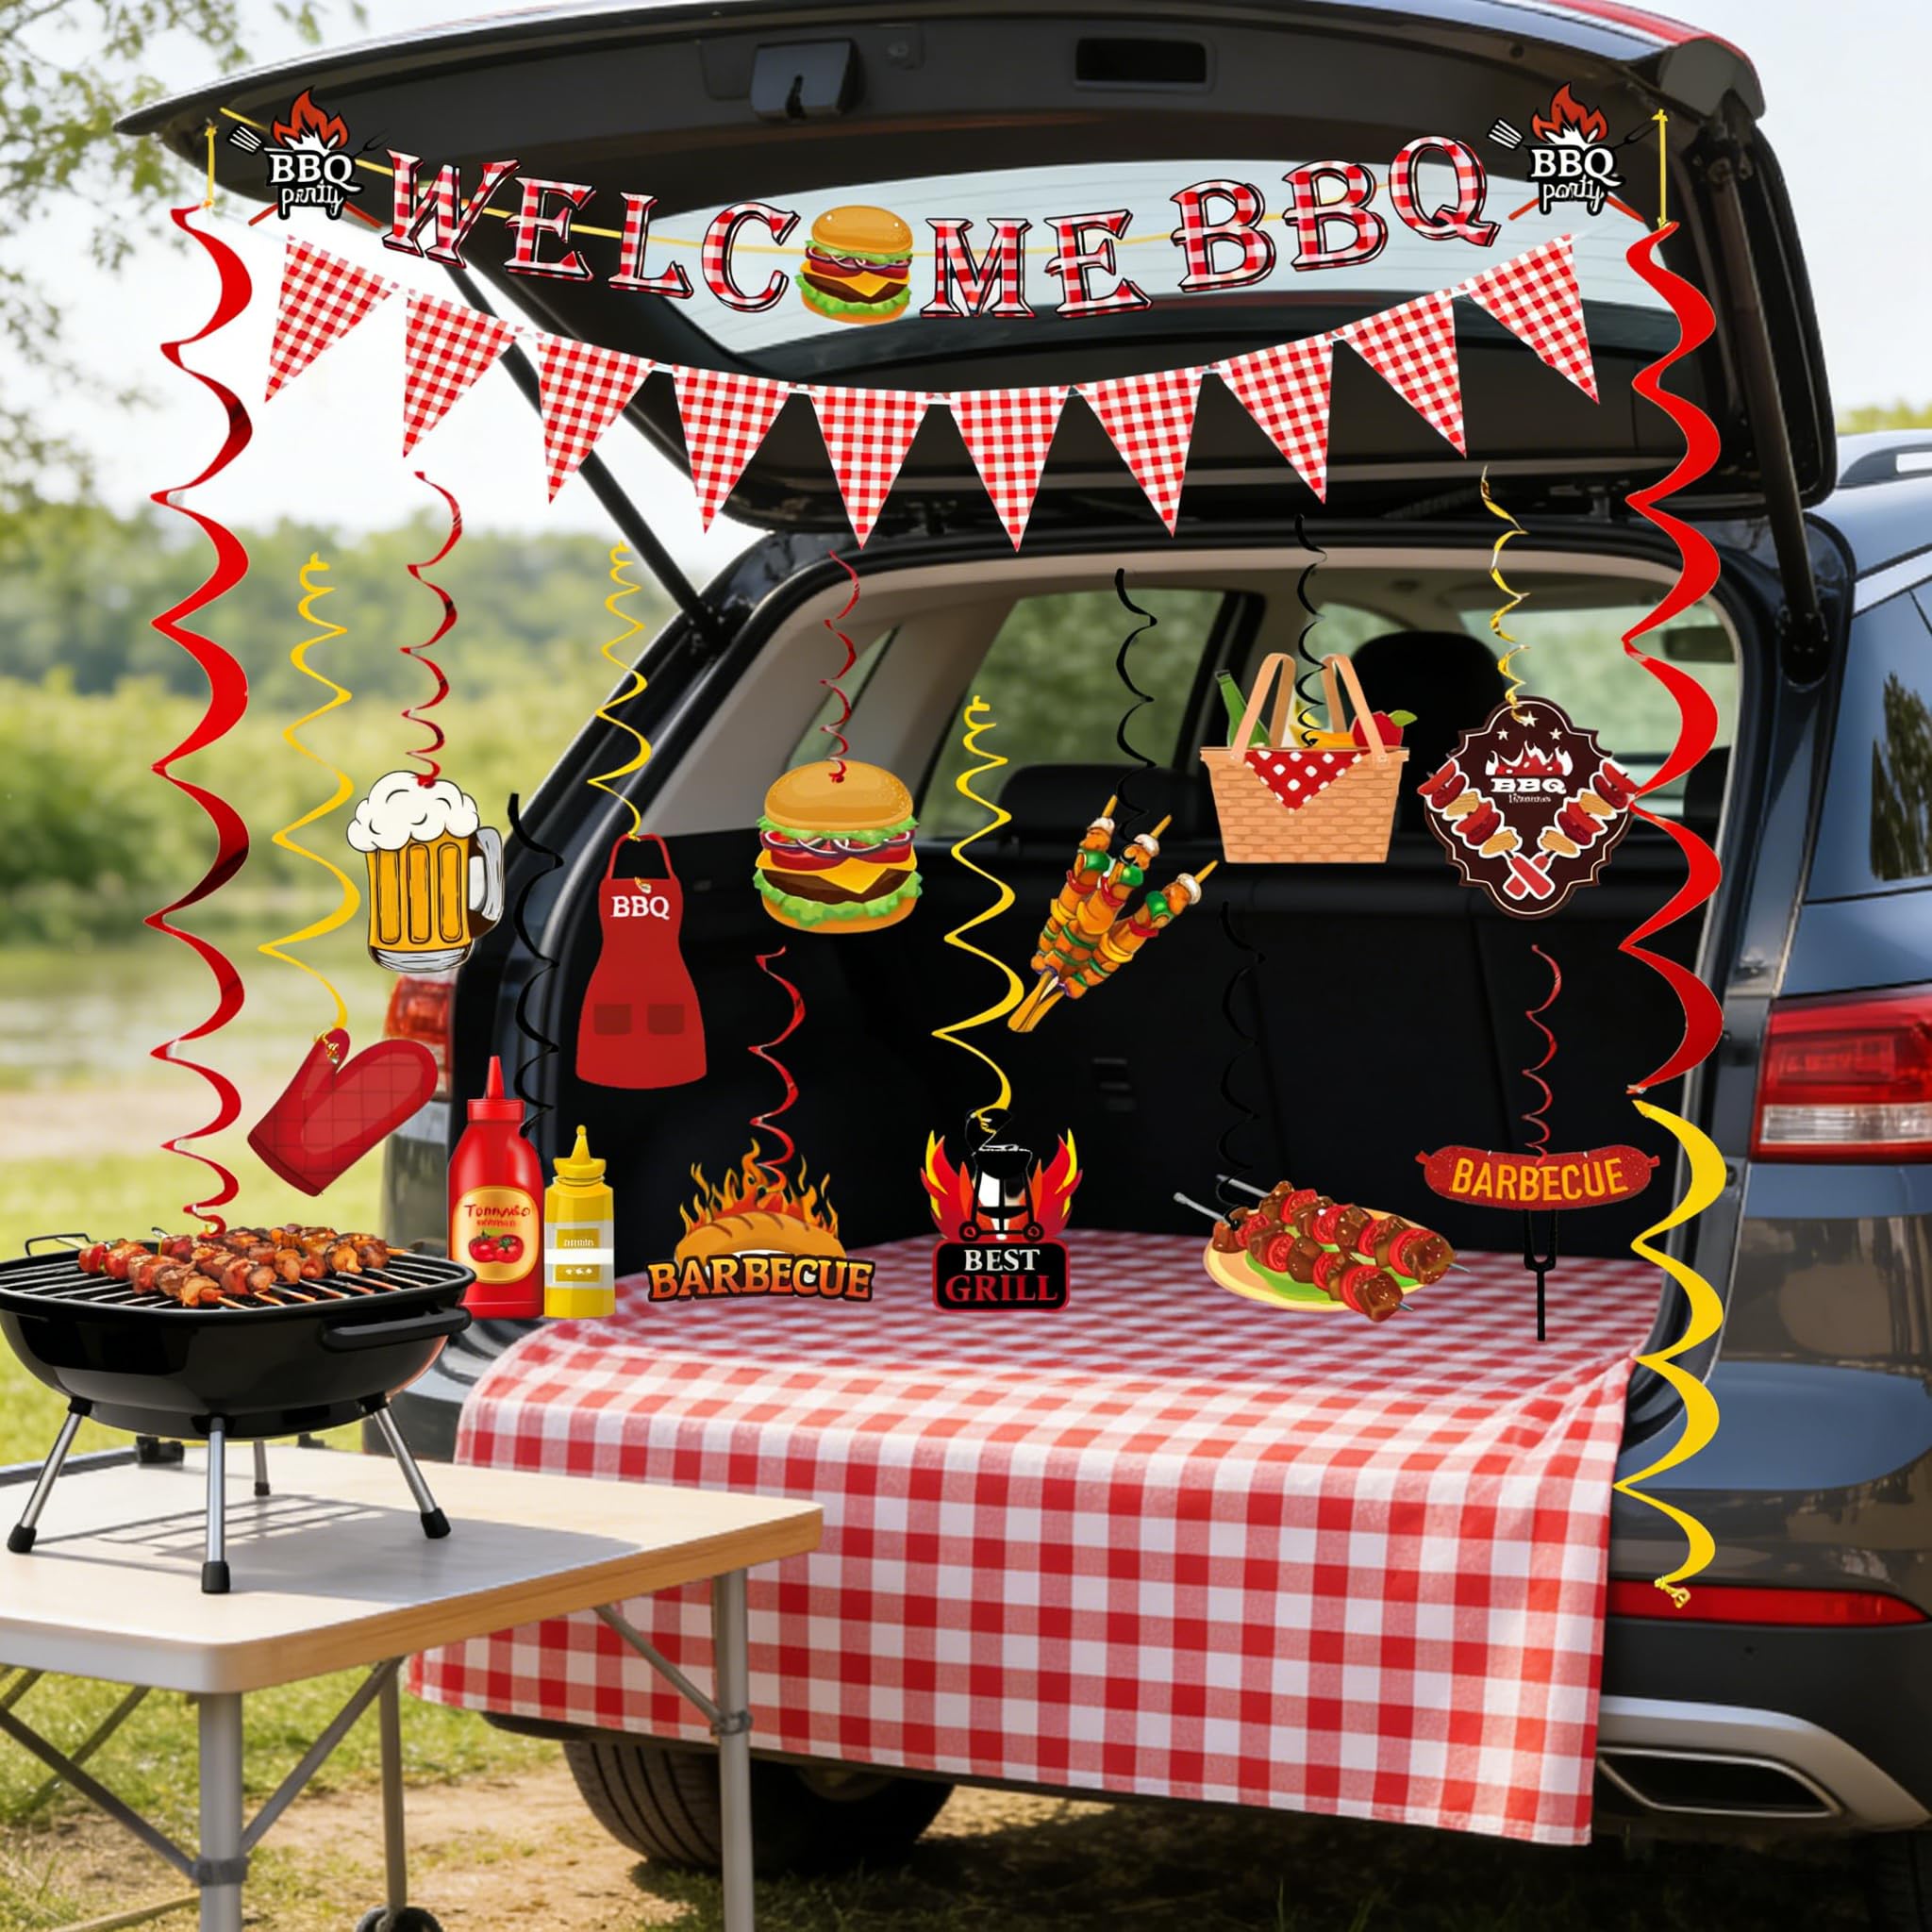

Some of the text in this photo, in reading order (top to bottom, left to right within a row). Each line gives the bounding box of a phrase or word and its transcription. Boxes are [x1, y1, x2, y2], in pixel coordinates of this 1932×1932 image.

[268, 153, 362, 192] BBQ
[1530, 147, 1623, 187] BBQ
[382, 135, 1500, 324] WELCME BBQ
[1490, 777, 1567, 794] BBQ
[610, 895, 670, 921] BBQ
[1449, 1158, 1629, 1201] BARBECUE
[647, 1254, 874, 1302] BARBECUE
[963, 1248, 1041, 1273] BEST
[944, 1274, 1058, 1303] GRILL
